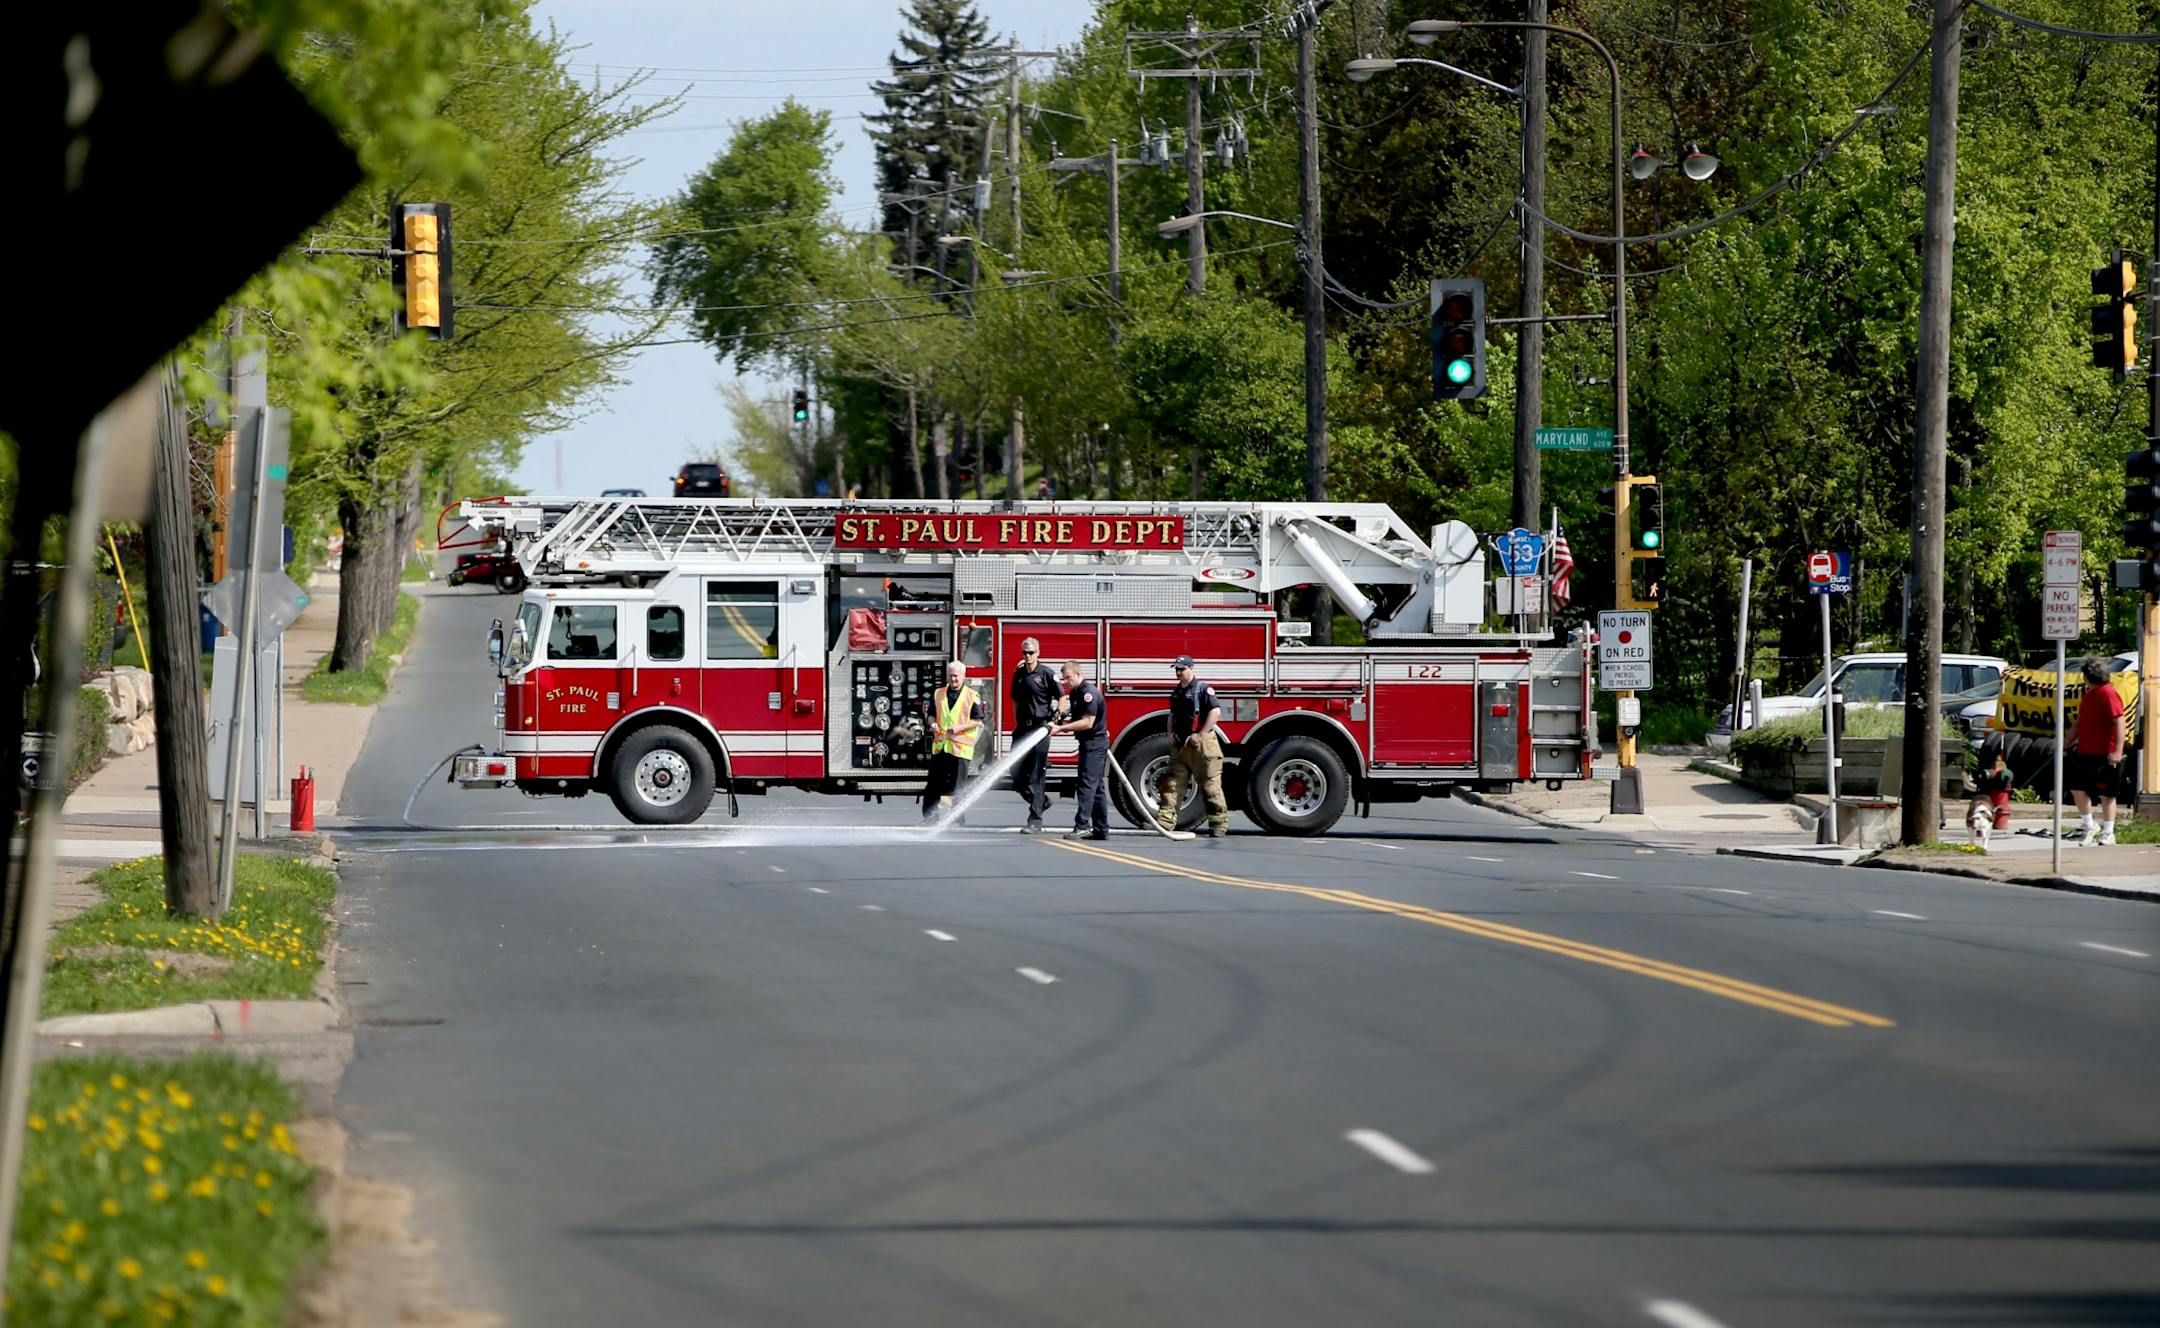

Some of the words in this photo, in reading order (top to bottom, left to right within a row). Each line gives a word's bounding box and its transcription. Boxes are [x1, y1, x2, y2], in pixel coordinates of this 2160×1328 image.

[1535, 432, 1589, 446] MARYLAND
[841, 518, 885, 542] ST.
[901, 519, 983, 543] PAUL
[1000, 519, 1074, 544] FIRE
[1091, 520, 1180, 544] DEPT.
[1509, 543, 1533, 563] 53
[2047, 558, 2064, 567] 4-6
[2066, 558, 2078, 567] PM
[1830, 575, 1847, 583] Bus
[1830, 583, 1851, 594] Stop
[2053, 591, 2070, 601] NO
[2046, 603, 2077, 613] PARKING
[1603, 617, 1616, 628] NO
[1620, 616, 1646, 627] TURN
[1606, 648, 1619, 658] ON
[1623, 647, 1644, 657] RED
[1614, 671, 1636, 679] PATROL
[2013, 676, 2055, 699] New
[546, 688, 564, 701] ST.
[569, 686, 599, 702] PAUL
[560, 703, 587, 713] FIRE
[2003, 702, 2056, 730] Used
